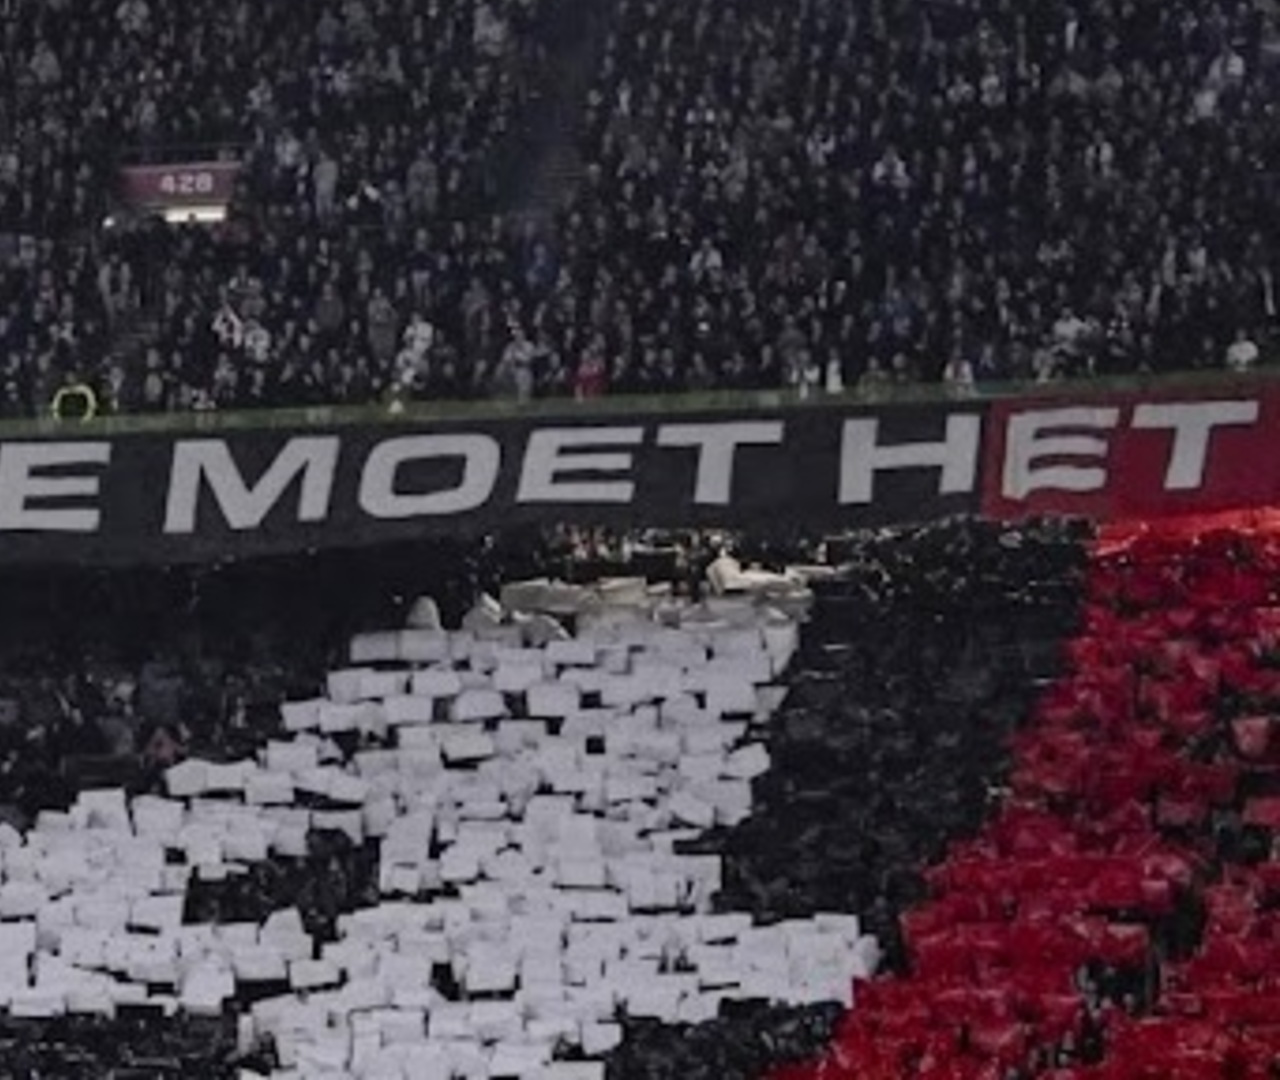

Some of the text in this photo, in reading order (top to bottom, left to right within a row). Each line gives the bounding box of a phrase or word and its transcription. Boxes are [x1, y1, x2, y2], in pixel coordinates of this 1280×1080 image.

[160, 172, 213, 193] 428
[162, 421, 784, 534] MOET
[838, 400, 1258, 504] HET
